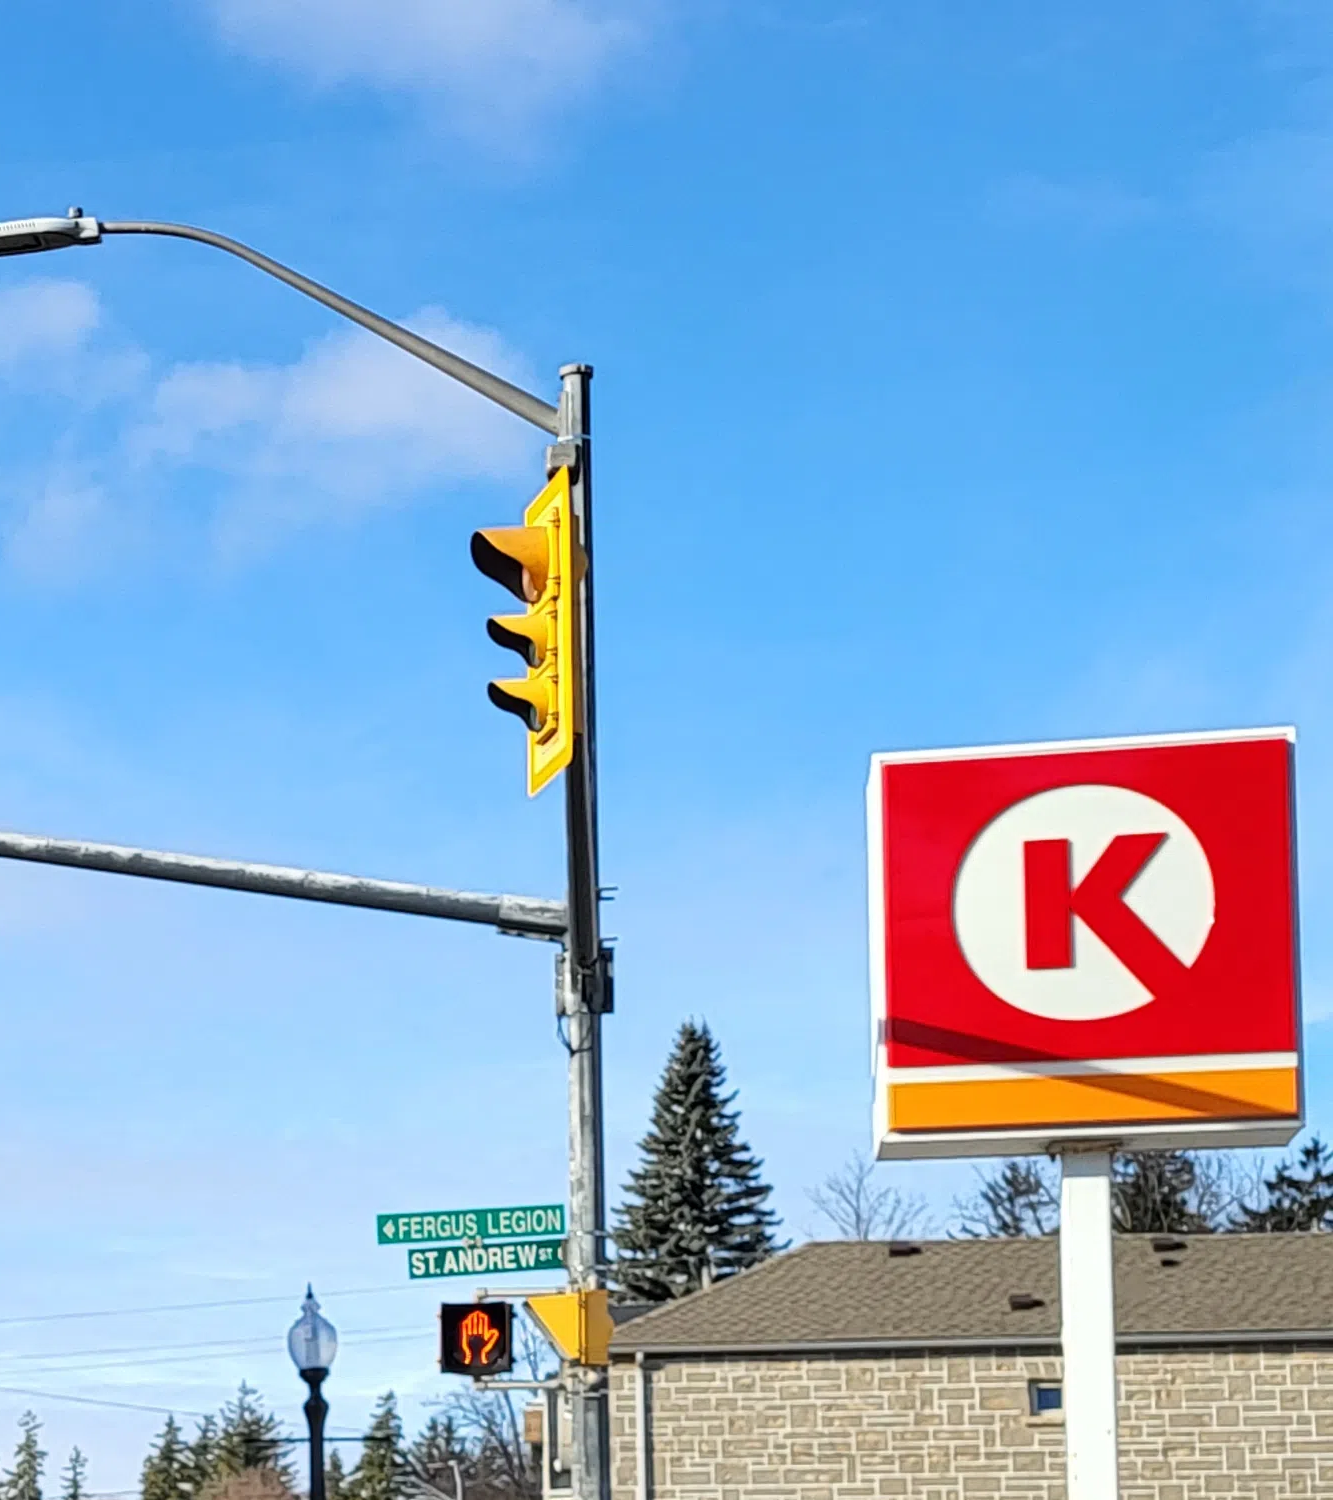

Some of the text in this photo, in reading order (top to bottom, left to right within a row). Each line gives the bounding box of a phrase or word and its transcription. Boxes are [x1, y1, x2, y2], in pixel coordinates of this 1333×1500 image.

[398, 1208, 562, 1240] FERGUS LEGION
[442, 1244, 538, 1274] ANDREW
[537, 1247, 553, 1262] ST
